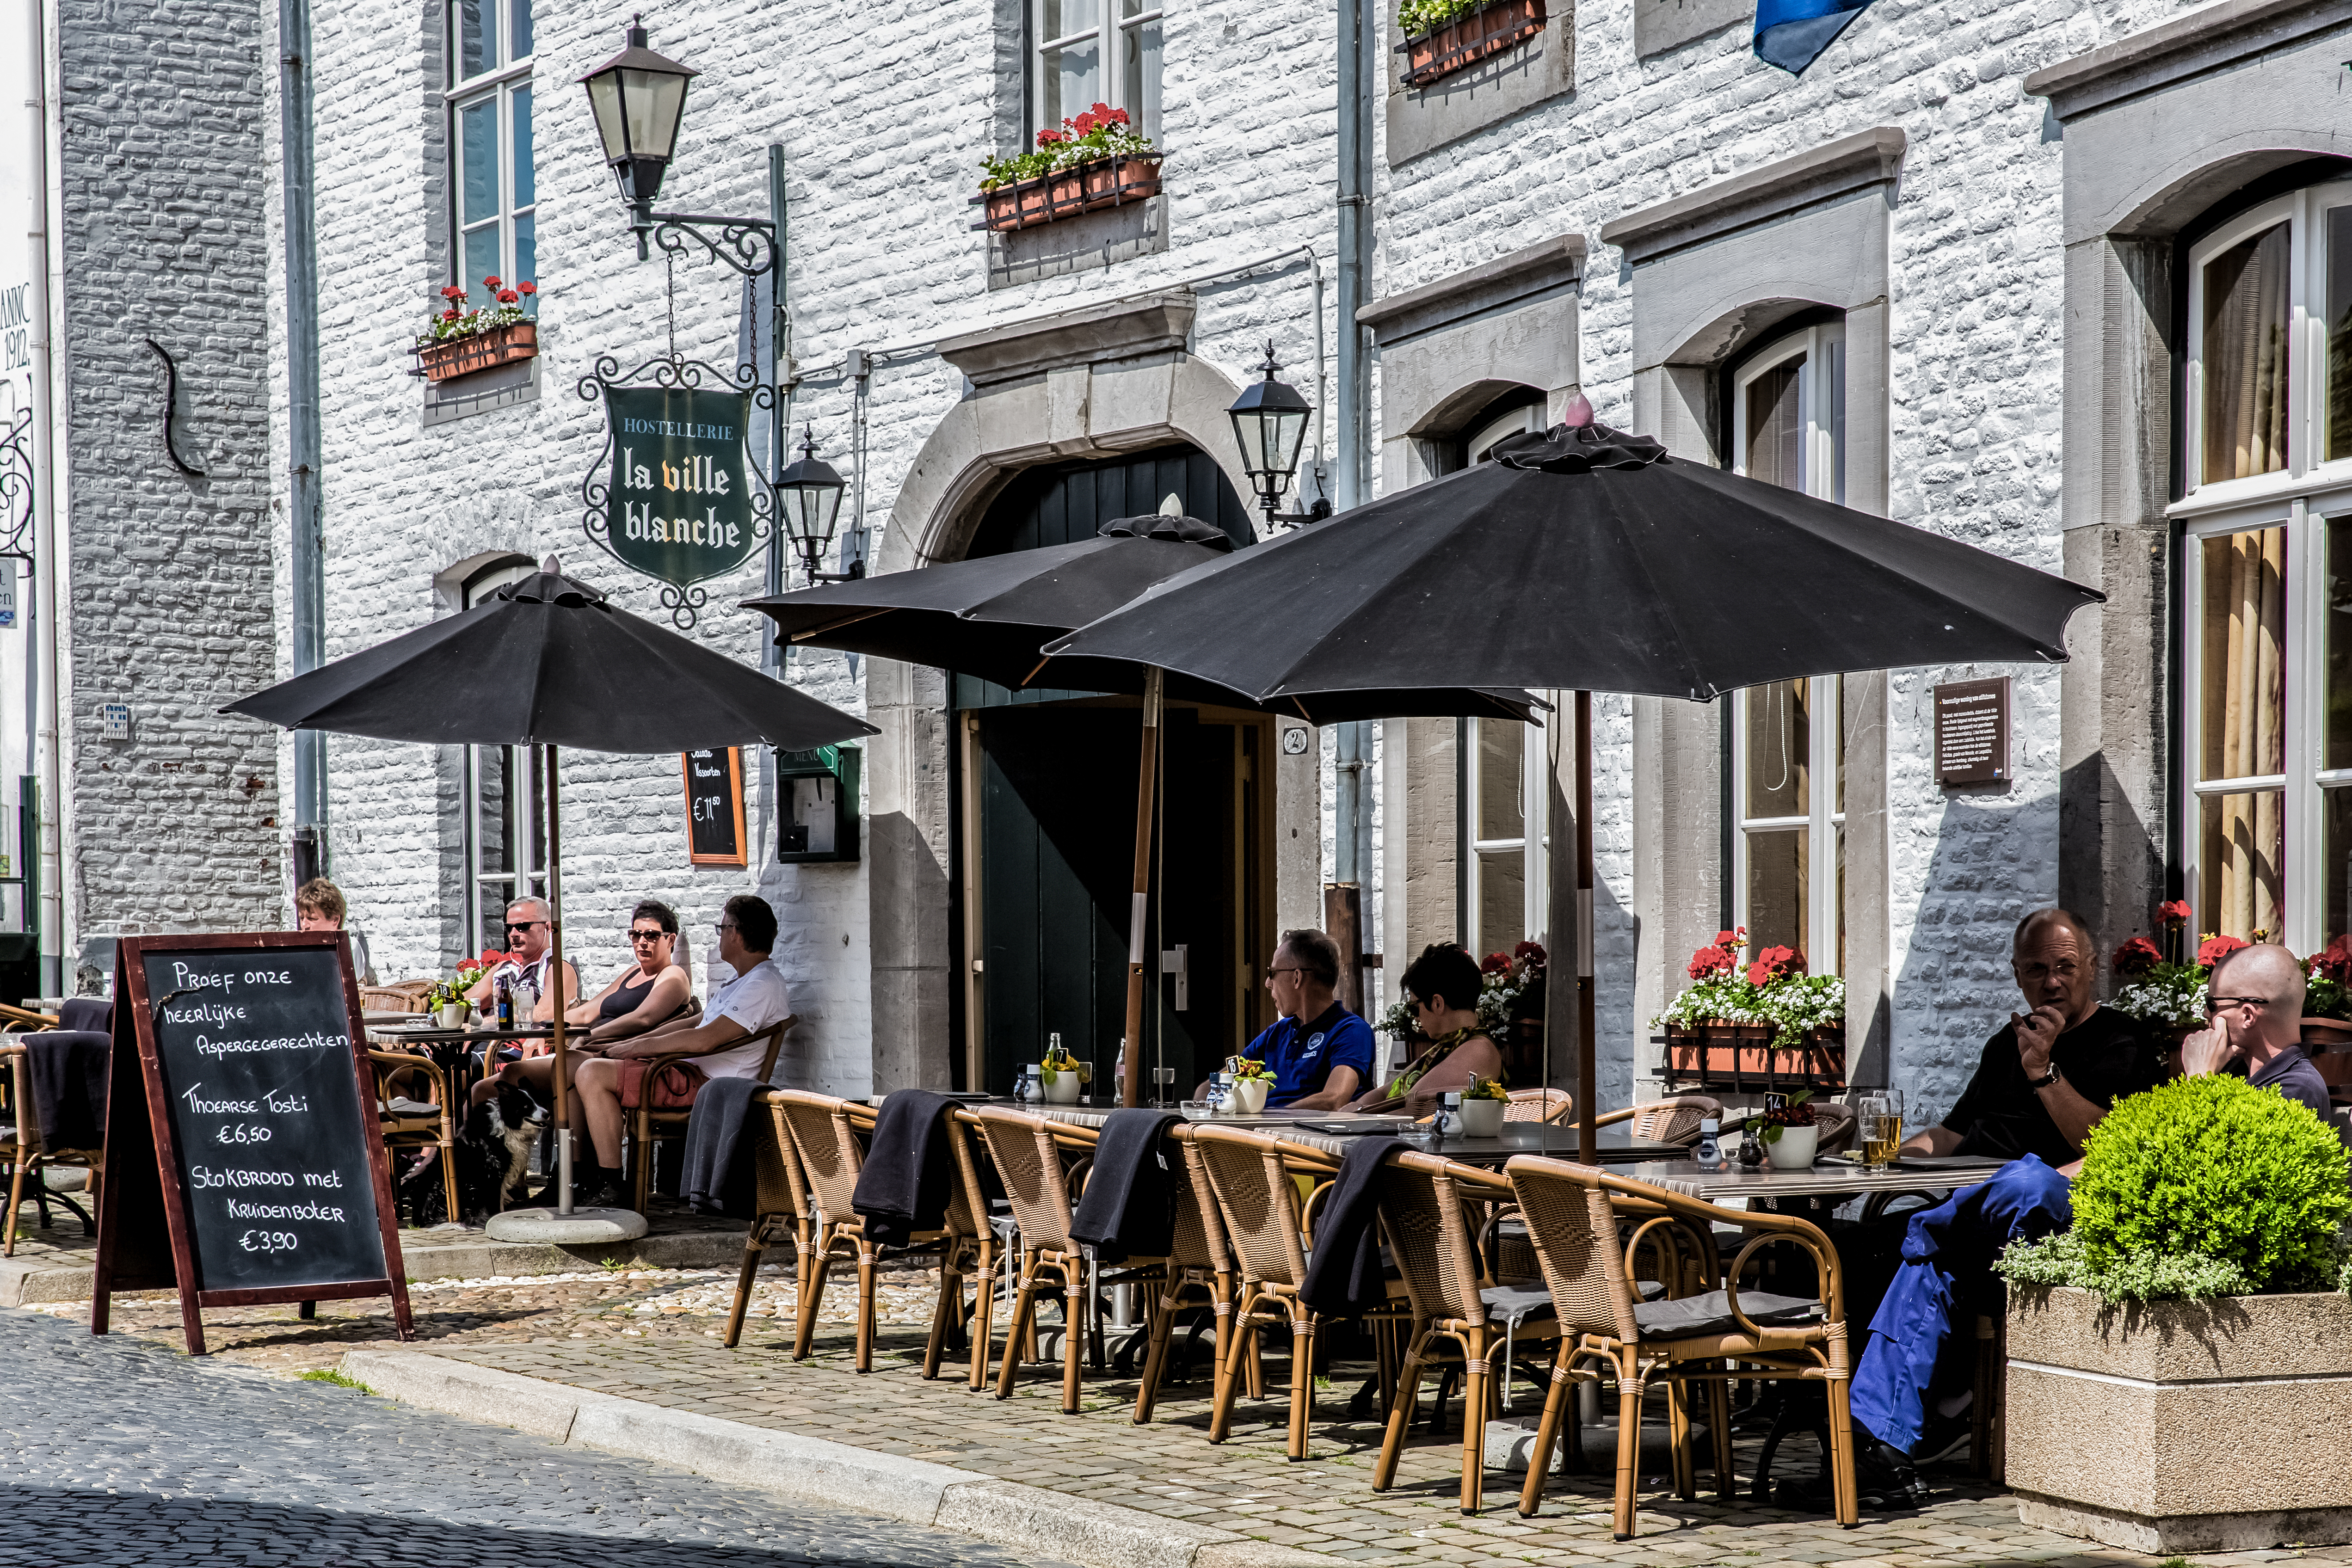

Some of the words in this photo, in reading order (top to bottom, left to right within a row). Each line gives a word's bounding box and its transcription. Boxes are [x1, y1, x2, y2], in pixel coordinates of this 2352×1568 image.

[624, 418, 733, 440] HOSTELLERIE
[624, 447, 654, 490] la
[662, 455, 730, 496] ville
[624, 500, 740, 548] blanche
[1292, 732, 1299, 748] 2
[794, 749, 819, 762] MENU
[695, 762, 720, 777] Vissoorten
[438, 985, 448, 996] 18
[1228, 1058, 1236, 1073] 16
[1469, 1075, 1474, 1090] 15
[1767, 1095, 1781, 1112] 14
[215, 1123, 272, 1146] €6,50
[238, 1230, 297, 1254] €3,90
